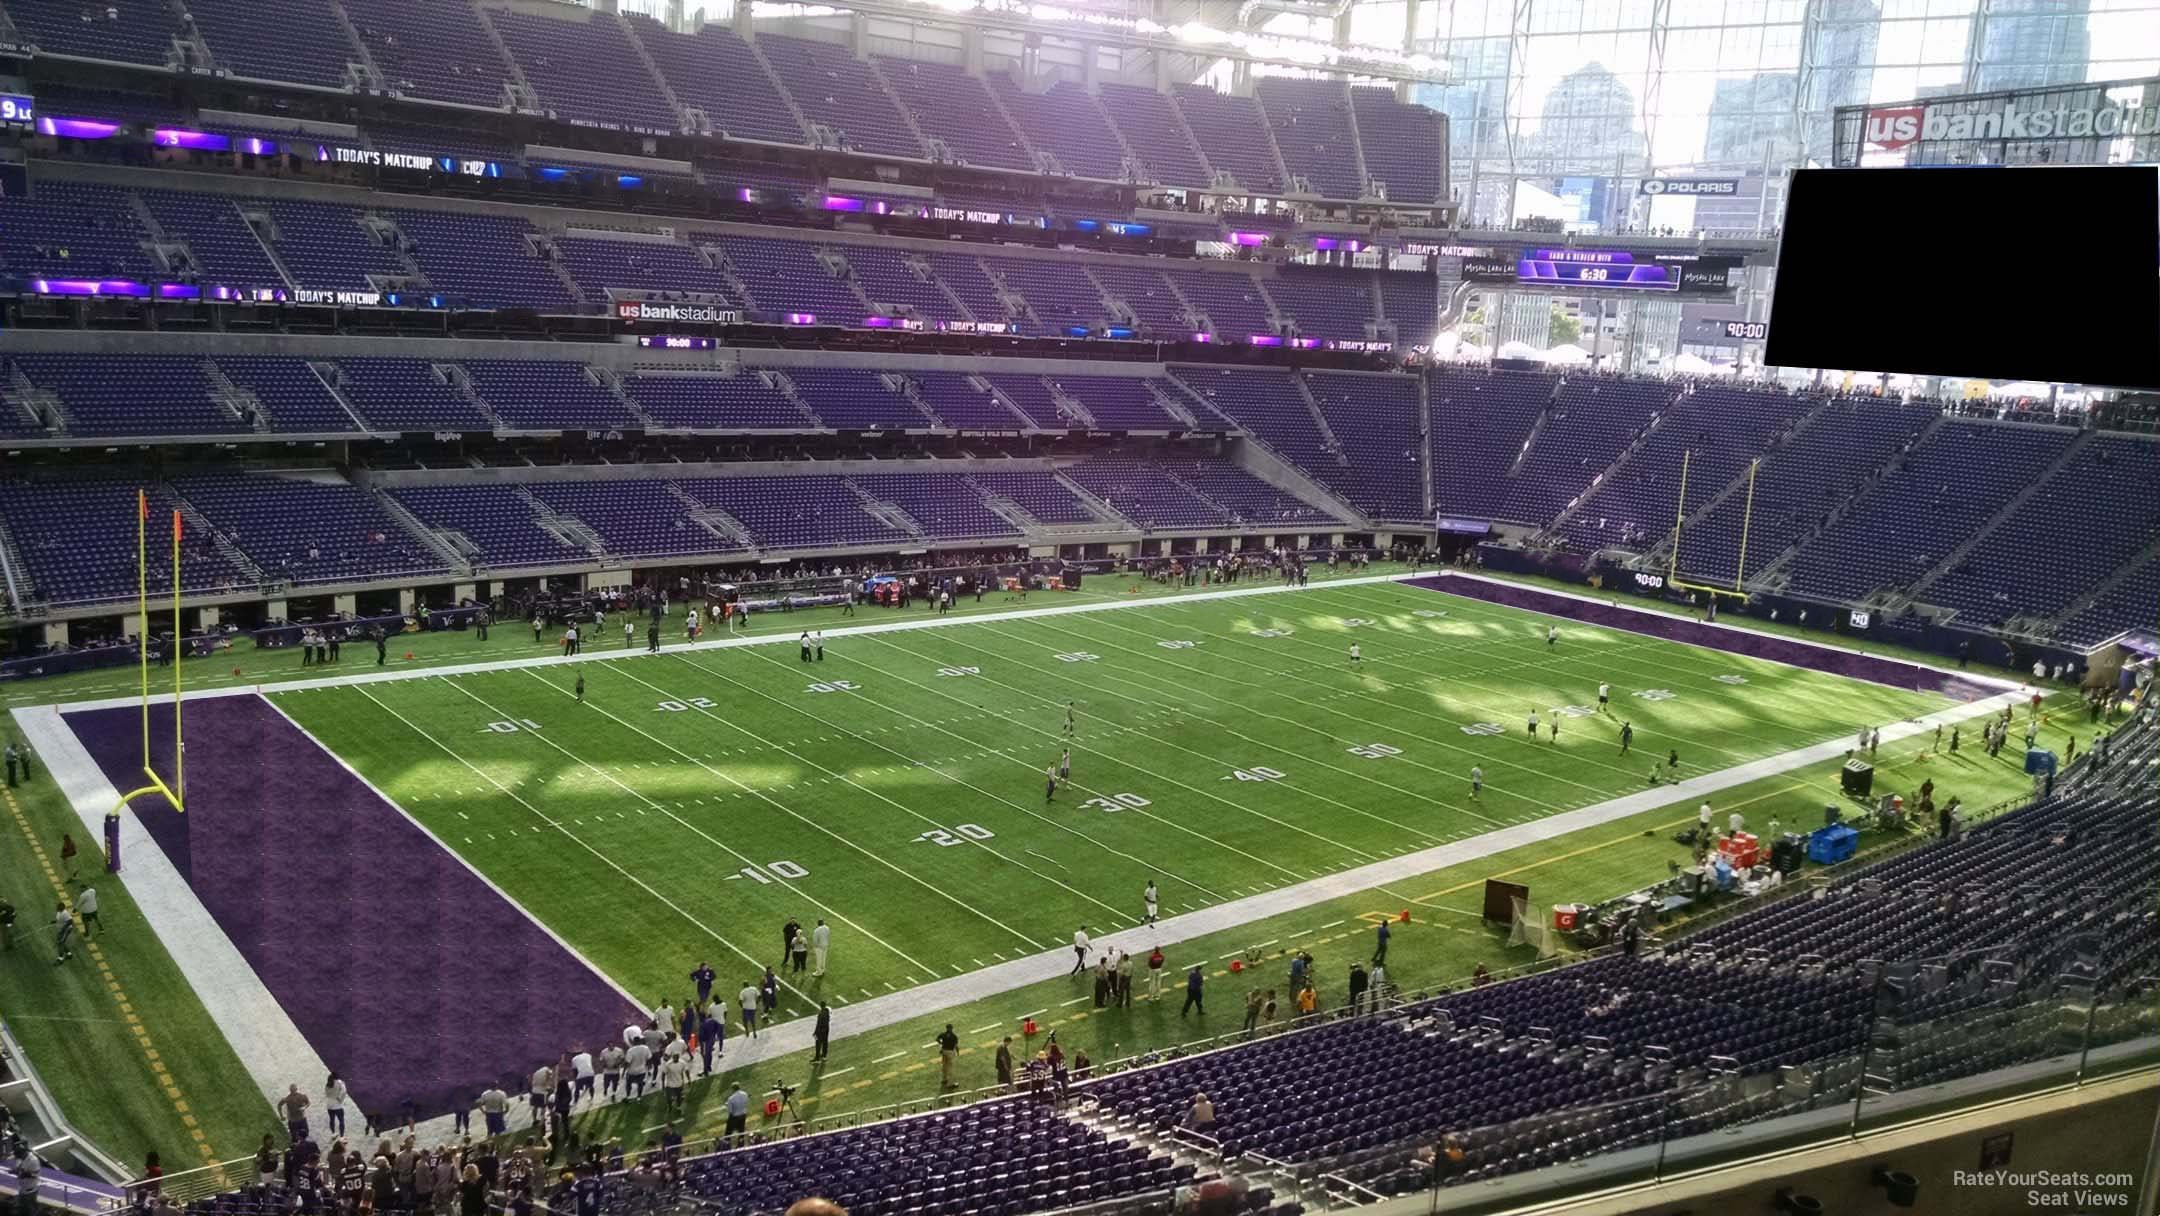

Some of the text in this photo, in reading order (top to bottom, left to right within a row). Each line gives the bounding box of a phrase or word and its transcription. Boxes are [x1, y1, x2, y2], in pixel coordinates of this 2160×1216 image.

[2, 101, 16, 119] 9
[336, 147, 433, 171] TODAY'S MATCHUP
[1667, 182, 1734, 193] POLARIS
[934, 207, 1001, 225] TODAY'S MATCHUP
[1407, 244, 1439, 256] TODAY'S
[1580, 268, 1608, 281] 6:30
[294, 289, 381, 306] TODAY'S MATCHUP
[1727, 322, 1765, 338] 90:00
[1635, 572, 1663, 588] 90:00
[1345, 742, 1405, 759] 50
[1232, 766, 1288, 783] 40
[1085, 791, 1153, 813] 30
[919, 822, 996, 848] 20
[739, 859, 811, 885] 10
